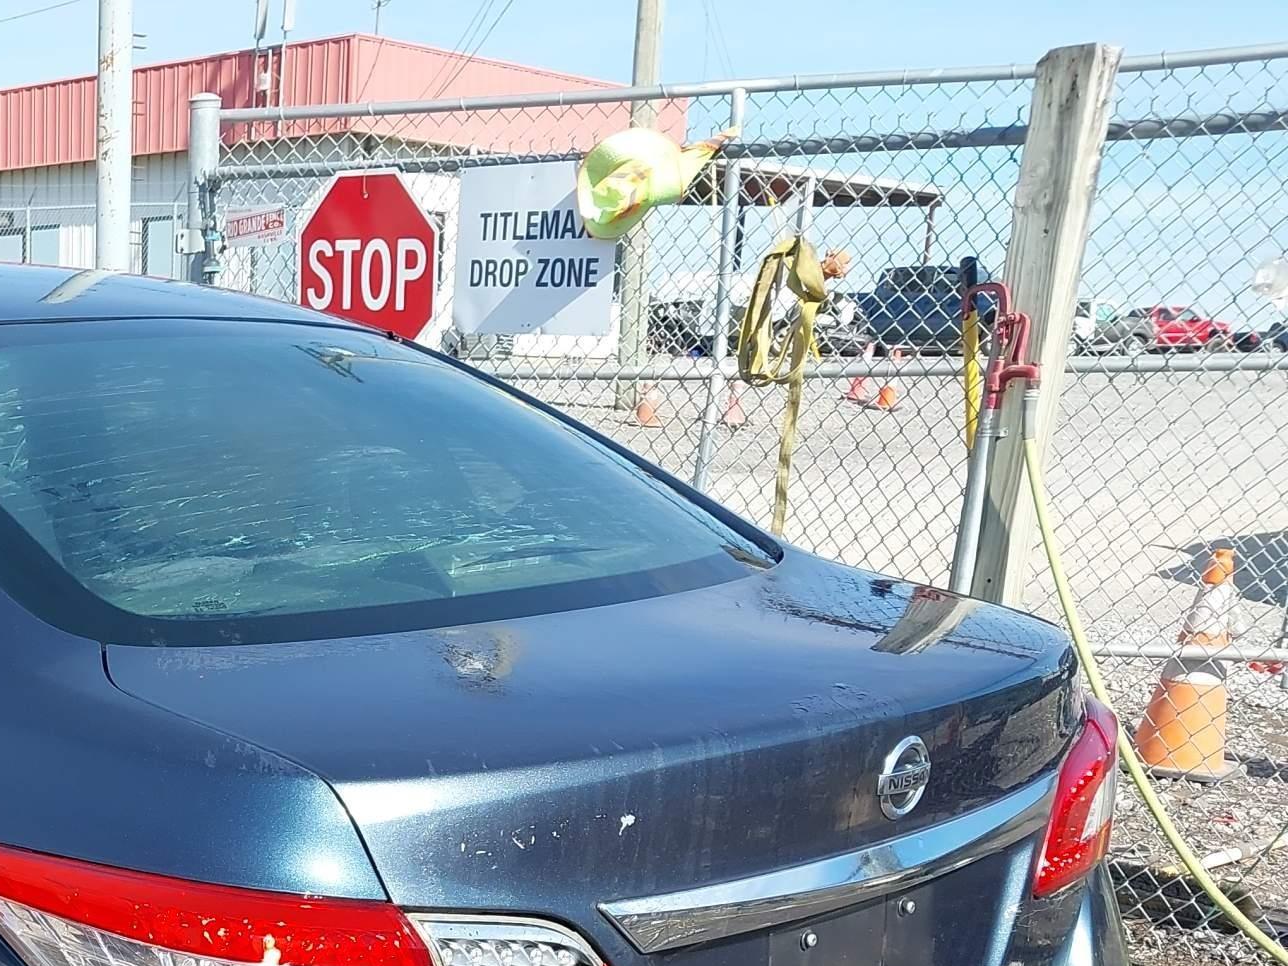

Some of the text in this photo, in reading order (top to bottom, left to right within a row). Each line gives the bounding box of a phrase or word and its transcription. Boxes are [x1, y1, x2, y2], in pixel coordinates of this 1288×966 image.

[307, 238, 427, 311] STOP
[469, 257, 600, 288] DROP ZONE
